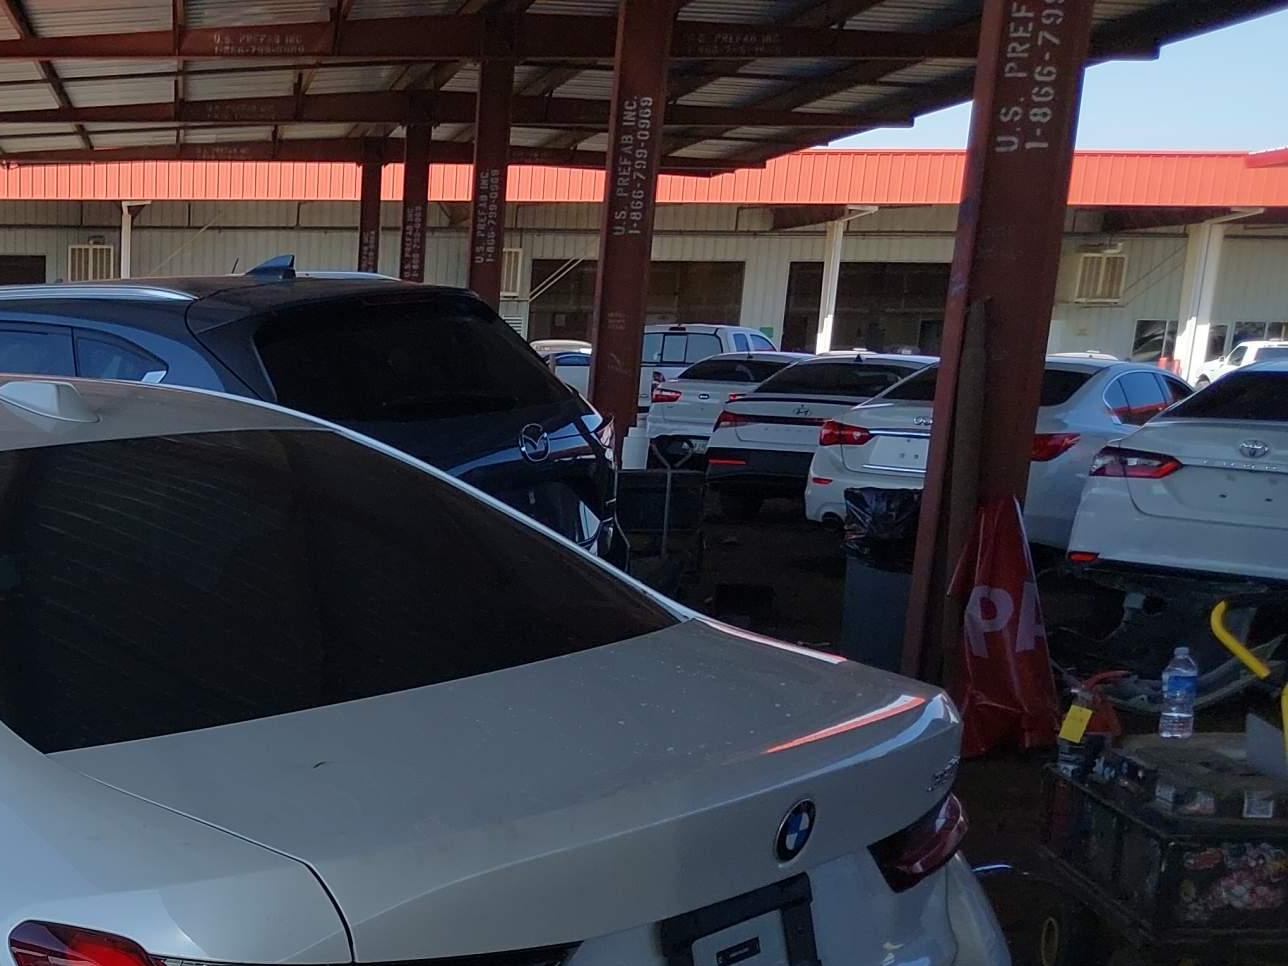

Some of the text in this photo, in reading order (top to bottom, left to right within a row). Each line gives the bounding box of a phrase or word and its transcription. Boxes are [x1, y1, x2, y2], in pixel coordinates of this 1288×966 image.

[994, 97, 1025, 152] U.S.
[1025, 0, 1064, 149] 1-866-79
[613, 95, 638, 235] U.S. PREFAB INC.
[628, 96, 654, 235] 1-866-799-0969
